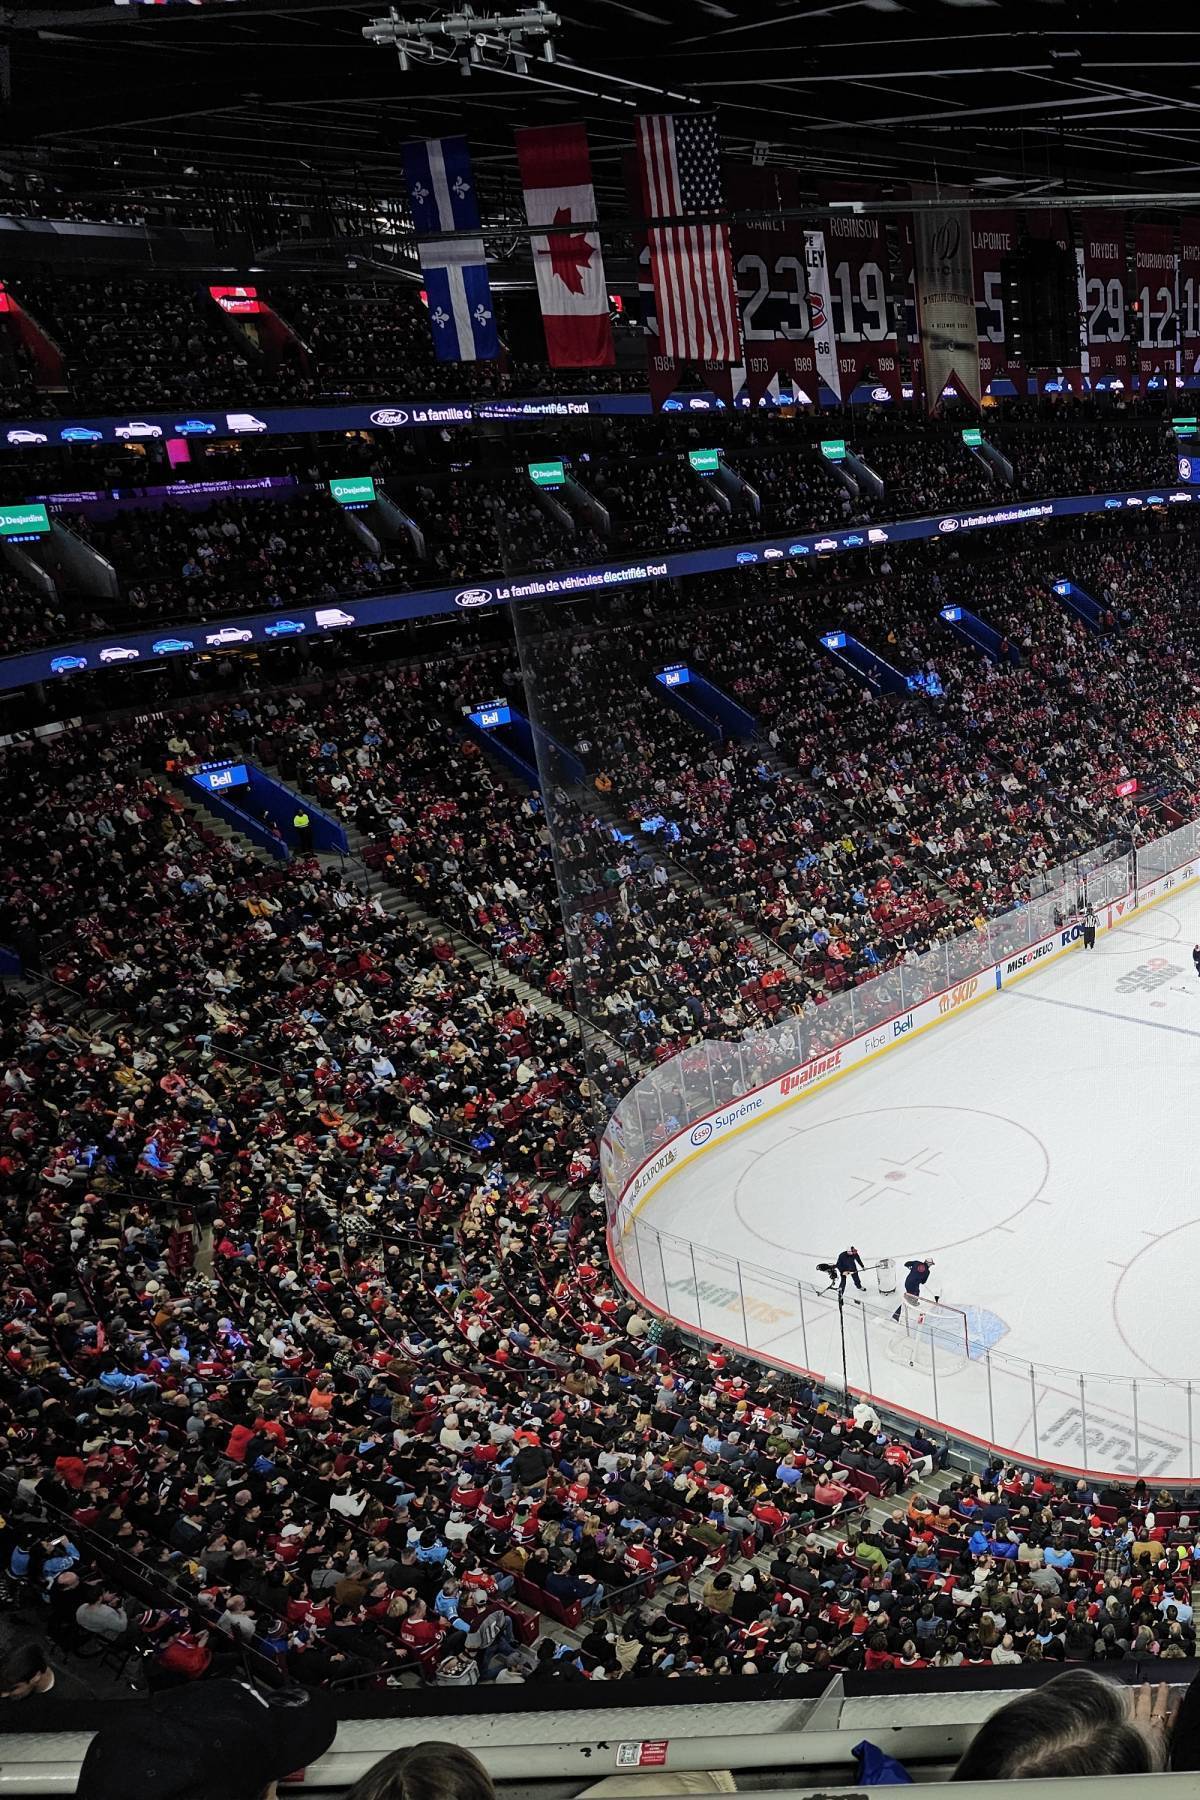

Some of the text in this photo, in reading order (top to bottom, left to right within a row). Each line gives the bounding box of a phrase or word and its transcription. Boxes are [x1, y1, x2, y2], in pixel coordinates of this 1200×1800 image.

[830, 217, 879, 239] ROBINSON
[972, 232, 1011, 250] LAPOINTE
[1090, 242, 1119, 259] DRYDEN
[807, 250, 825, 268] LEY
[1136, 251, 1174, 270] COURNOYER
[738, 255, 810, 340] 23
[835, 262, 888, 343] 19
[984, 272, 1005, 343] 5
[1086, 278, 1125, 343] 29
[1139, 286, 1176, 349] 12
[653, 356, 675, 371] 1984
[750, 358, 769, 372] 1973
[794, 357, 812, 371] 1989
[839, 358, 856, 373] 1972
[878, 358, 895, 371] 1989
[413, 410, 427, 422] La
[428, 408, 463, 421] famille
[569, 402, 589, 414] Ford
[344, 486, 371, 494] Desjardins
[6, 514, 44, 525] Desjardins
[960, 519, 968, 527] La
[969, 516, 986, 527] famille
[987, 514, 994, 523] de
[994, 511, 1017, 522] véhicules
[1042, 505, 1053, 514] Ford
[496, 564, 667, 599] La famille de véhicules électrifiés Ford
[666, 673, 679, 684] Bell
[482, 712, 498, 725] Bell
[210, 771, 232, 787] Bell
[950, 978, 978, 1009] SKIP
[864, 1013, 913, 1053] Fibe Bell
[779, 1050, 842, 1095] Qualinet
[715, 1098, 763, 1129] Suprême
[642, 1158, 670, 1187] EXPORT
